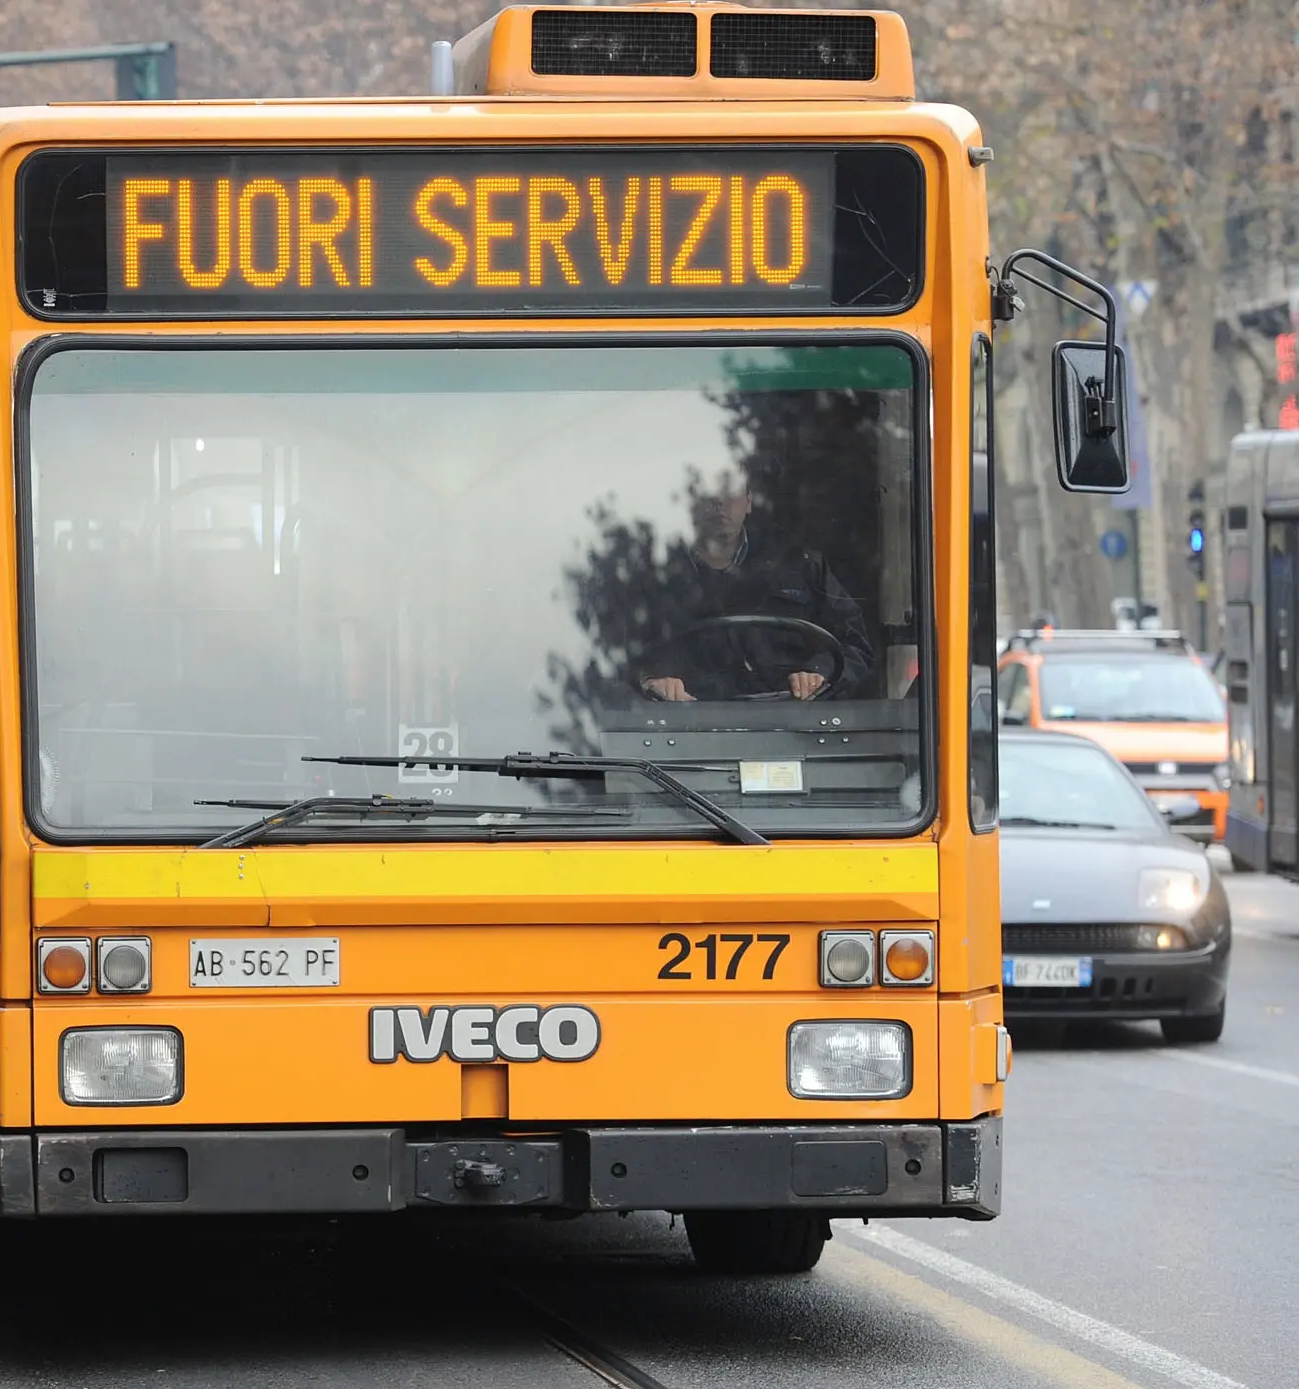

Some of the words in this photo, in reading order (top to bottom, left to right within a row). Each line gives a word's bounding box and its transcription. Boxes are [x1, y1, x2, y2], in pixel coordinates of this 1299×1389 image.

[124, 177, 374, 289] FUORI
[413, 175, 806, 287] SERVIZIO
[403, 731, 455, 778] 28
[194, 950, 224, 977] AB
[242, 950, 290, 977] 562
[305, 949, 336, 976] PF
[657, 932, 791, 981] 2177
[371, 1005, 599, 1062] IVECO
